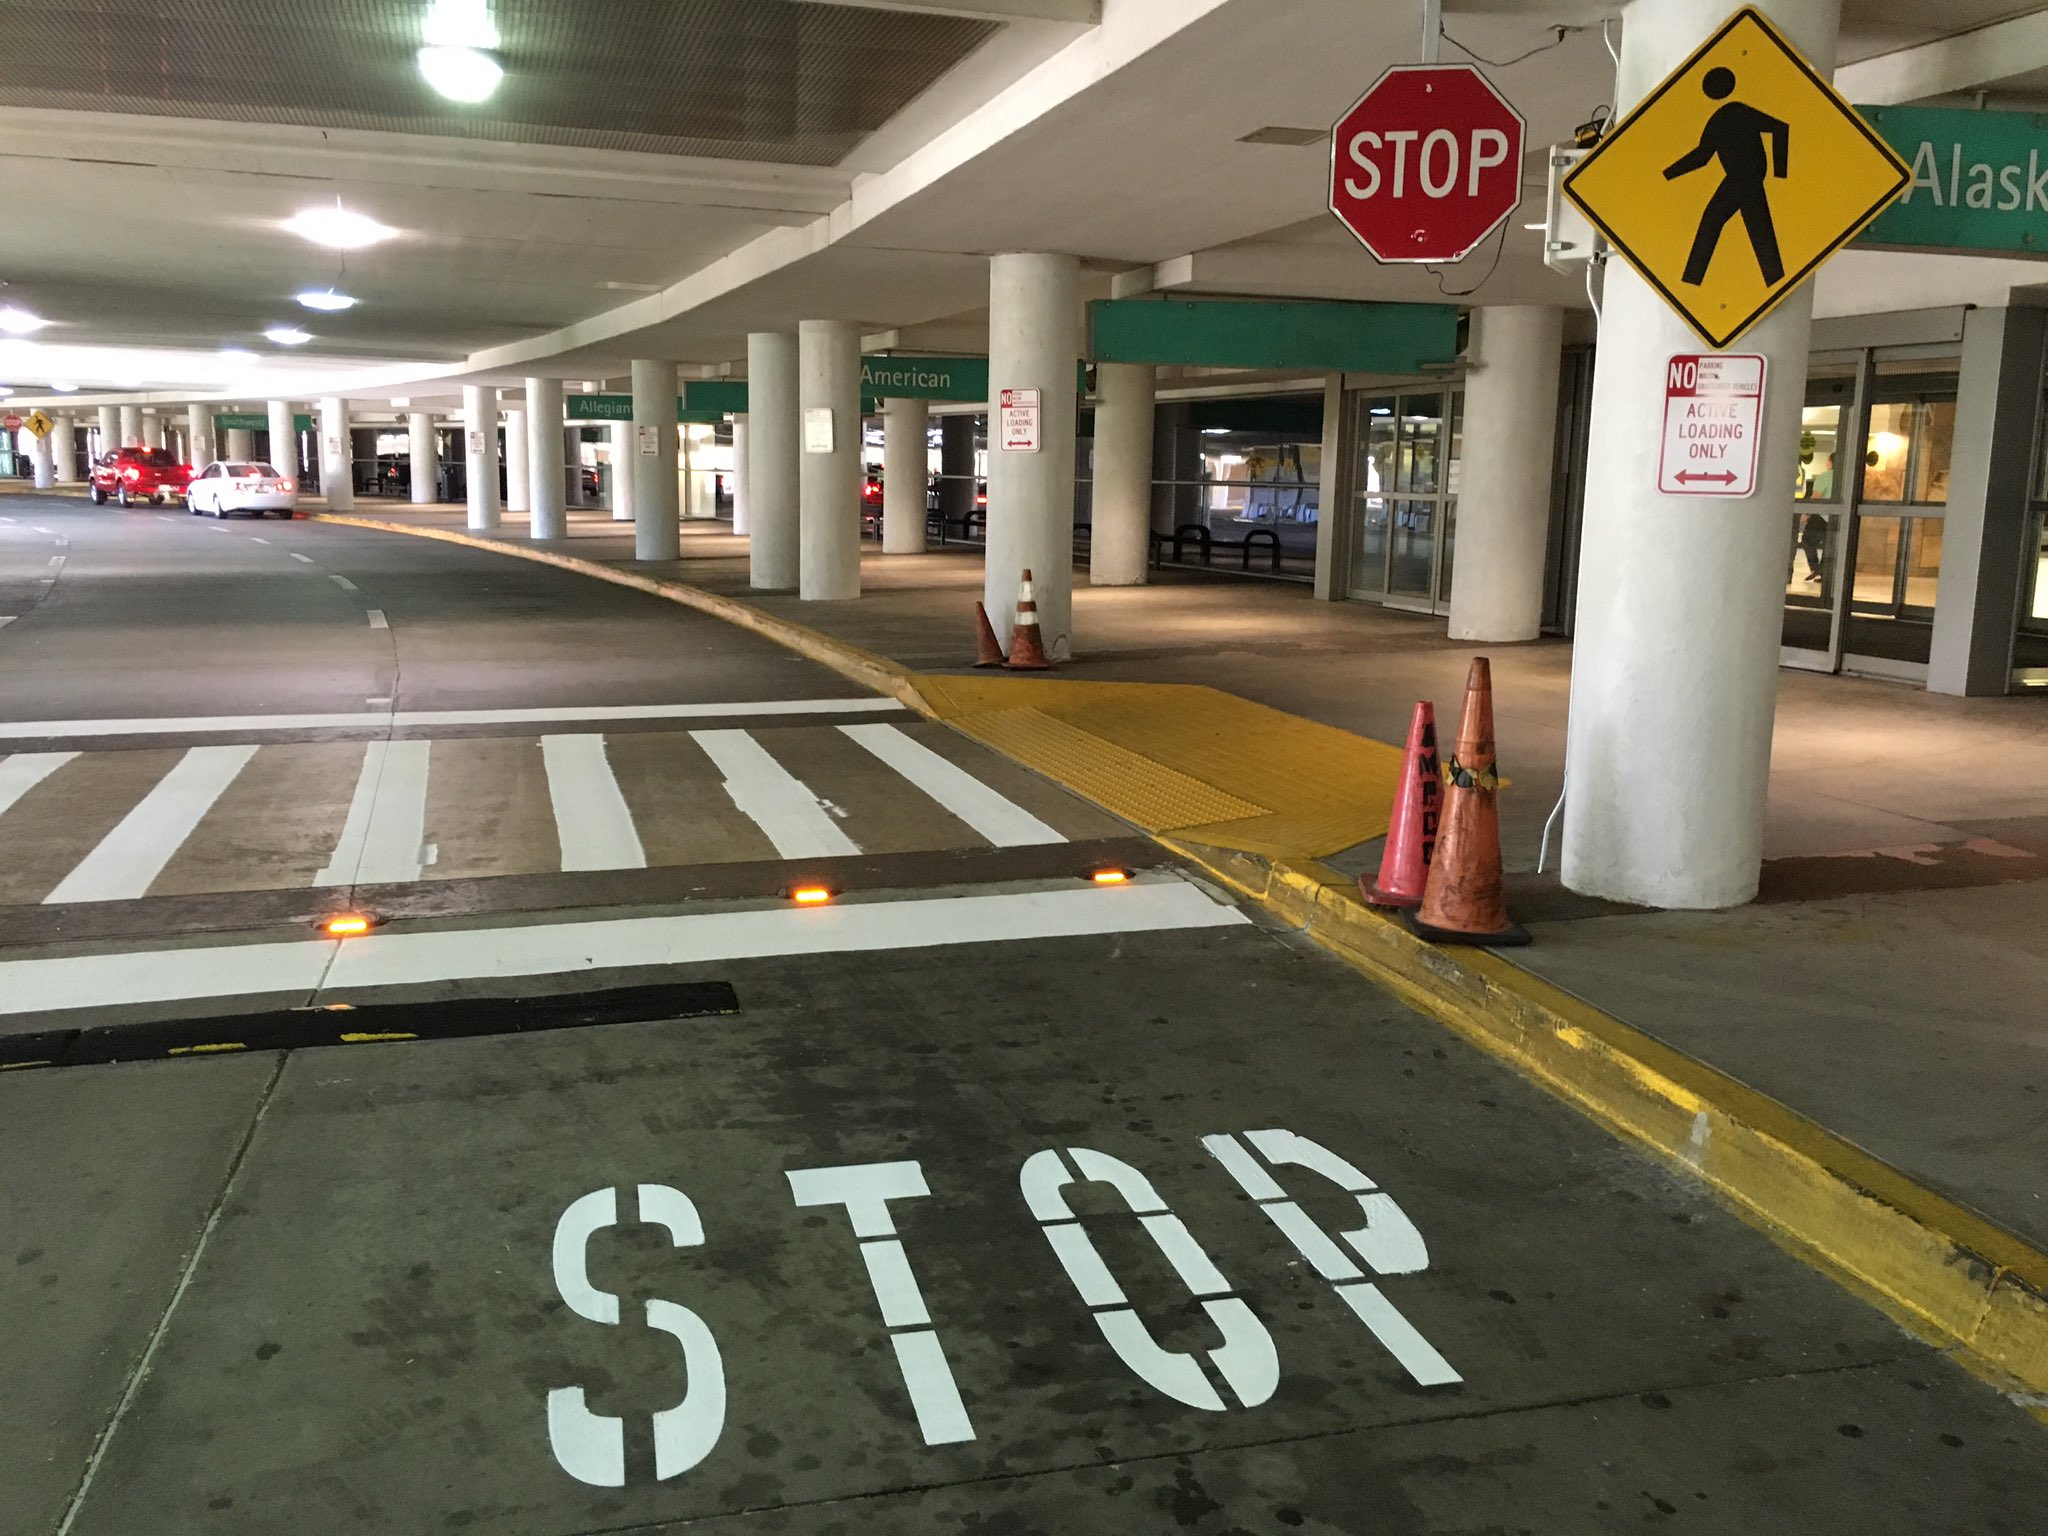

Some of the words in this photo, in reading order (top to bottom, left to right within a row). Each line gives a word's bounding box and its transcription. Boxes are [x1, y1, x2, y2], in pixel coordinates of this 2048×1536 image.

[1344, 128, 1509, 200] STOP
[1900, 141, 2048, 211] Alask
[860, 364, 951, 388] American
[1669, 362, 1697, 389] NO
[1001, 392, 1012, 405] NO
[580, 400, 633, 416] Allegian
[1687, 403, 1738, 419] ACTIVE
[1007, 419, 1033, 427] LOADING
[1011, 428, 1028, 436] ONLY
[1678, 424, 1743, 439] LOADING
[1689, 444, 1728, 459] ONLY
[547, 1129, 1464, 1487] STOP
